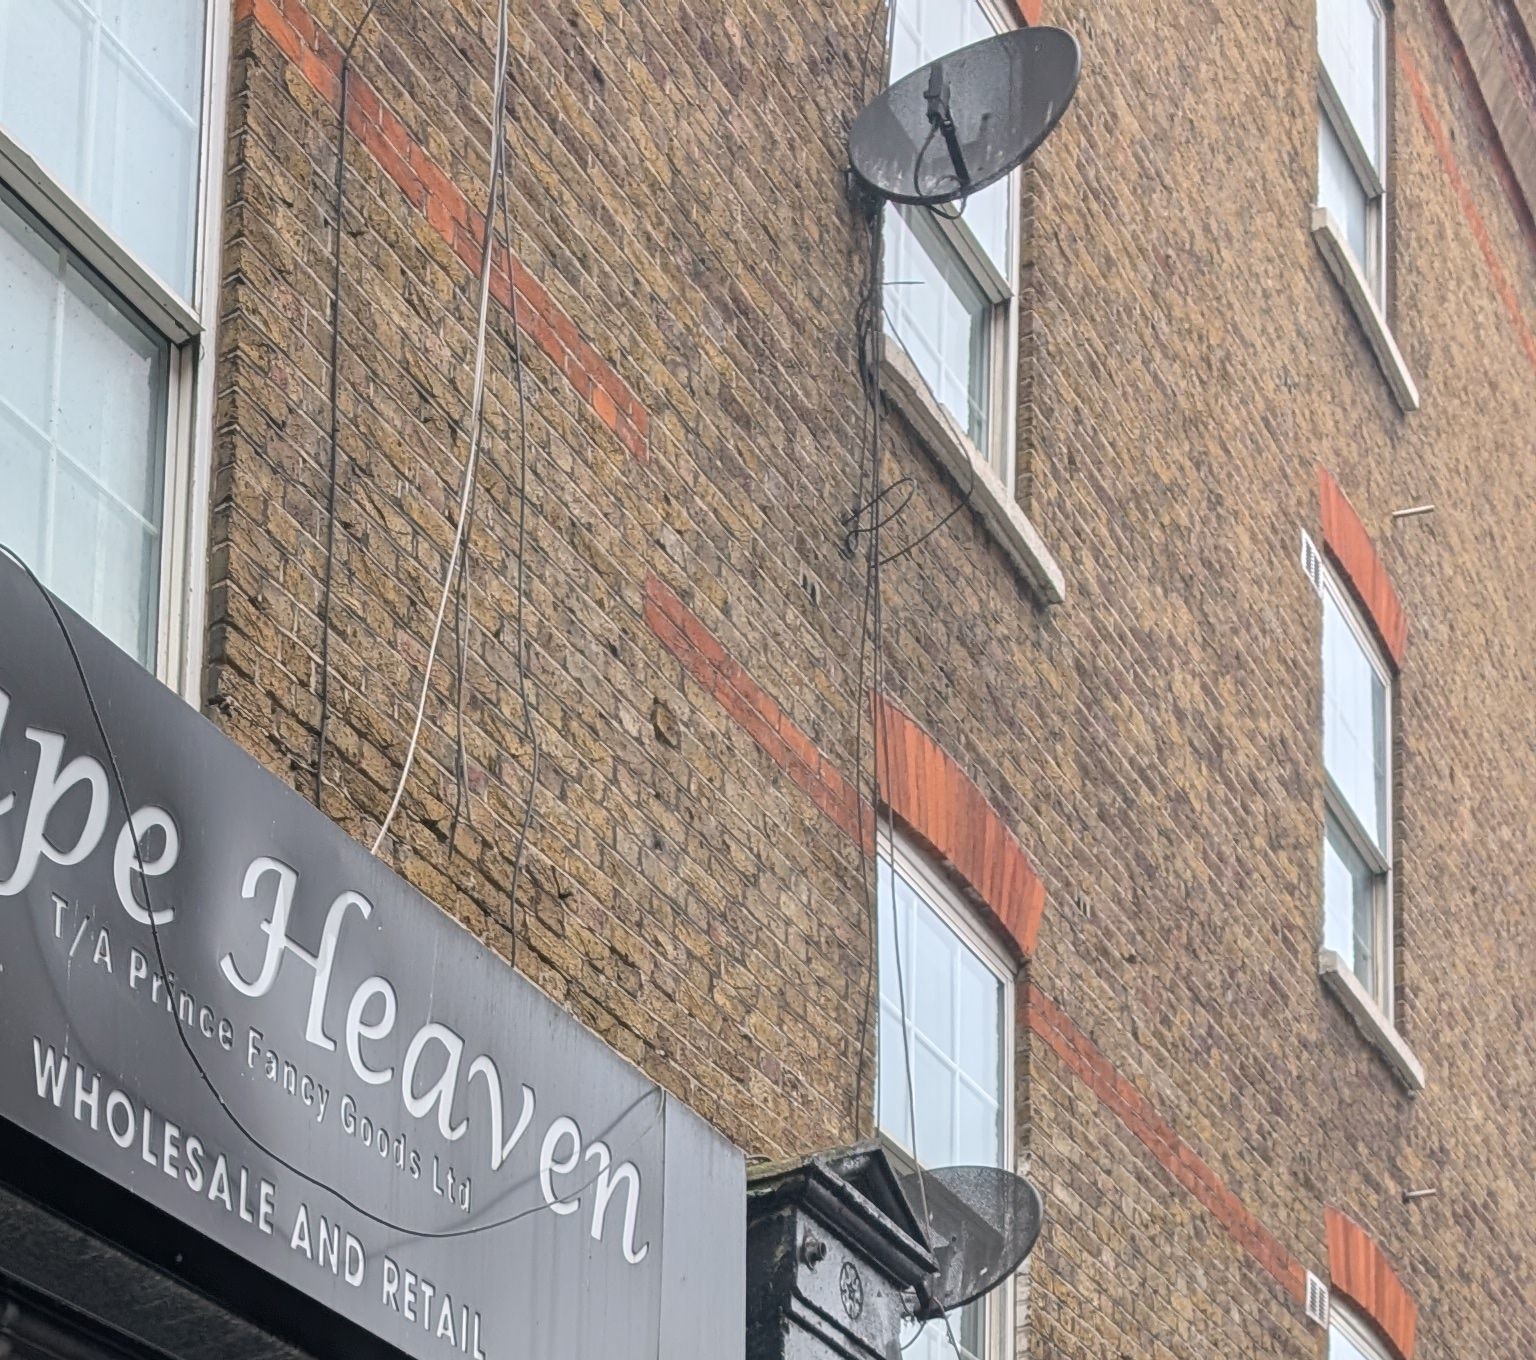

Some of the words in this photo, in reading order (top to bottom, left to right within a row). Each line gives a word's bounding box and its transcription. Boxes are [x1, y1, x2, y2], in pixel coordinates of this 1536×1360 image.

[32, 1036, 276, 1235] WHOLESALE
[290, 1203, 365, 1289] AND
[51, 892, 113, 974] T/A
[129, 947, 233, 1051] Prince
[247, 1026, 330, 1123] Fancy
[340, 1094, 422, 1180] Goods
[433, 1156, 471, 1214] Ltd
[222, 855, 649, 1264] Heaven
